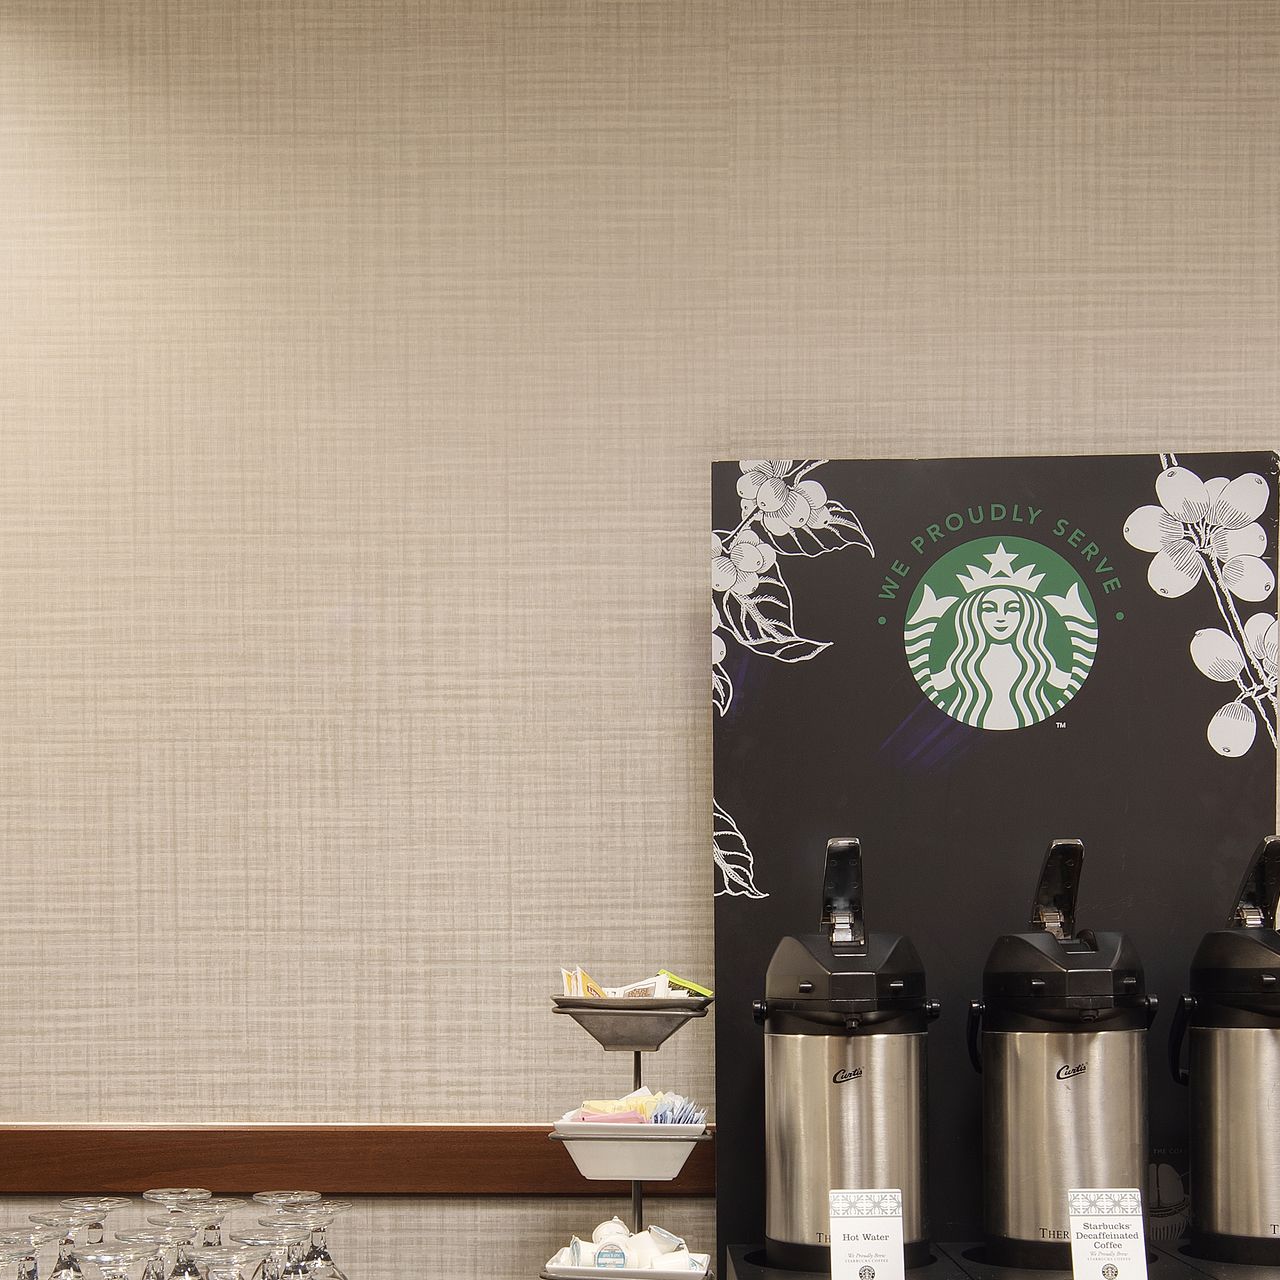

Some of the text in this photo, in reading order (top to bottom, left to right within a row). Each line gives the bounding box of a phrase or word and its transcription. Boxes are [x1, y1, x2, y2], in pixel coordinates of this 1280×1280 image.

[878, 503, 1122, 600] WE PROUDLY SERVE
[832, 1067, 863, 1084] Curtis
[1056, 1063, 1086, 1080] Curtis
[1082, 1222, 1131, 1230] Starbucks
[842, 1233, 890, 1241] Hot Water
[1076, 1232, 1139, 1240] Decaffeinated
[1093, 1241, 1123, 1249] Coffee
